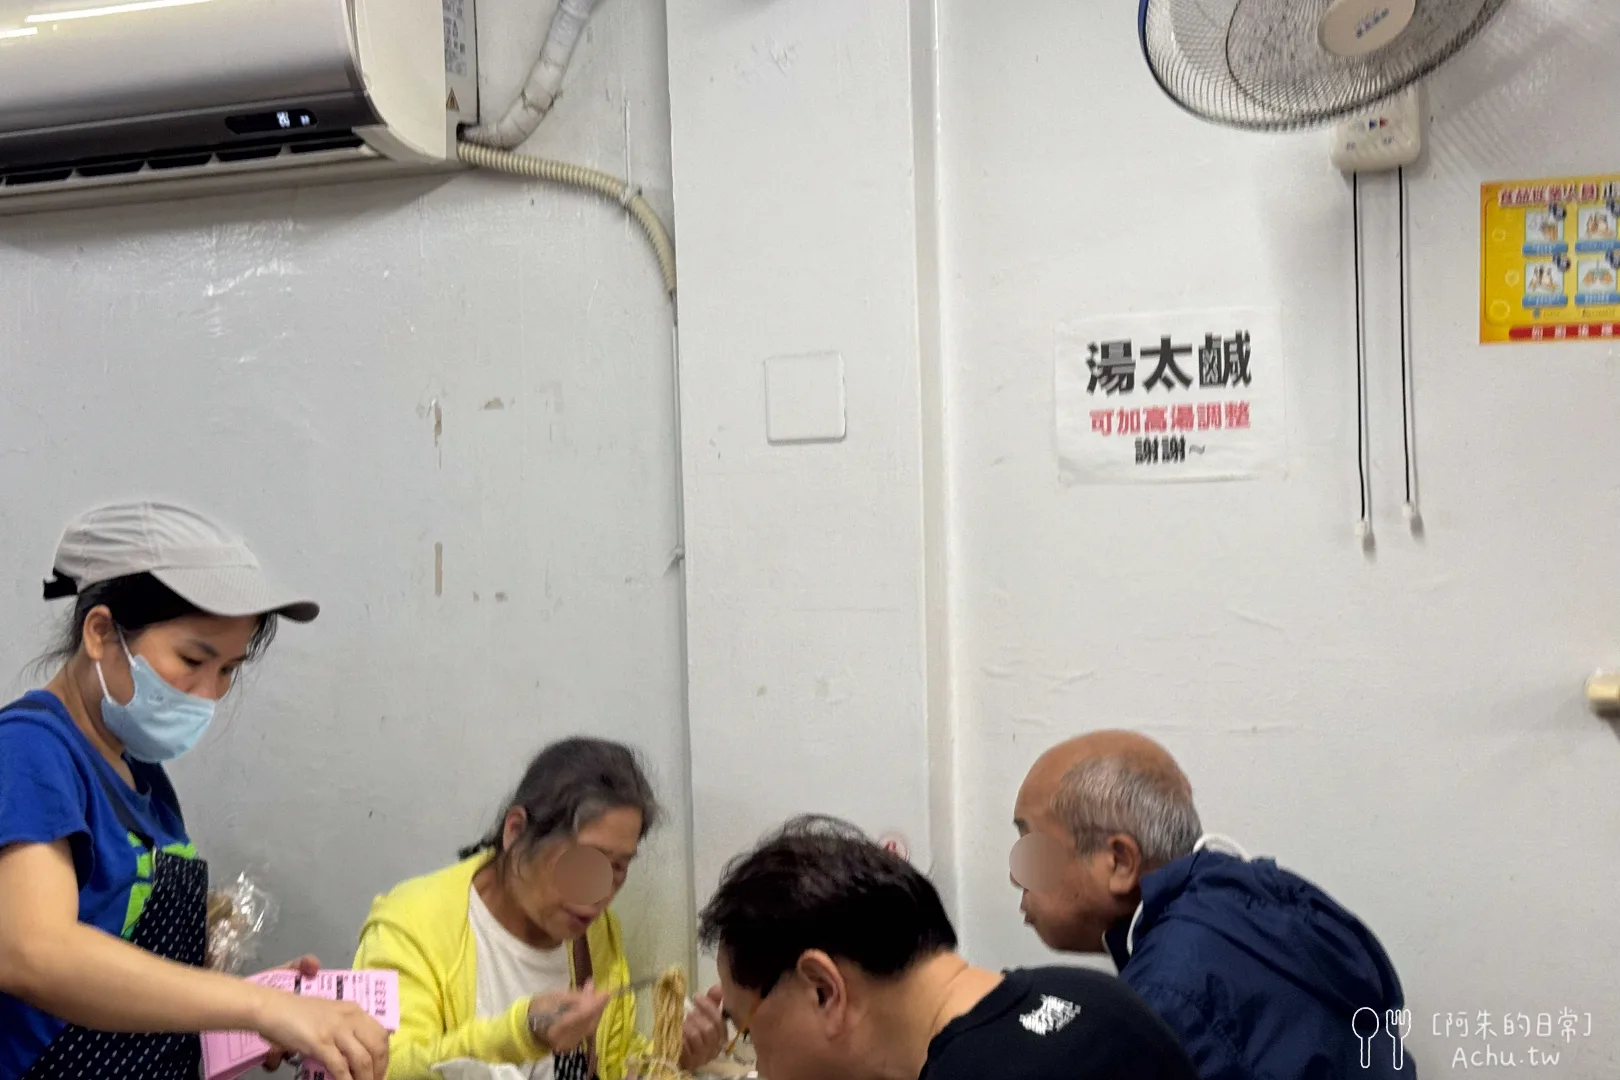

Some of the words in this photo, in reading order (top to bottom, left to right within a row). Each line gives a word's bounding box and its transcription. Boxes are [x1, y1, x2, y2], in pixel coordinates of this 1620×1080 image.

[1086, 330, 1252, 396] 湯太鹹
[1090, 401, 1250, 434] 可加高湯調整
